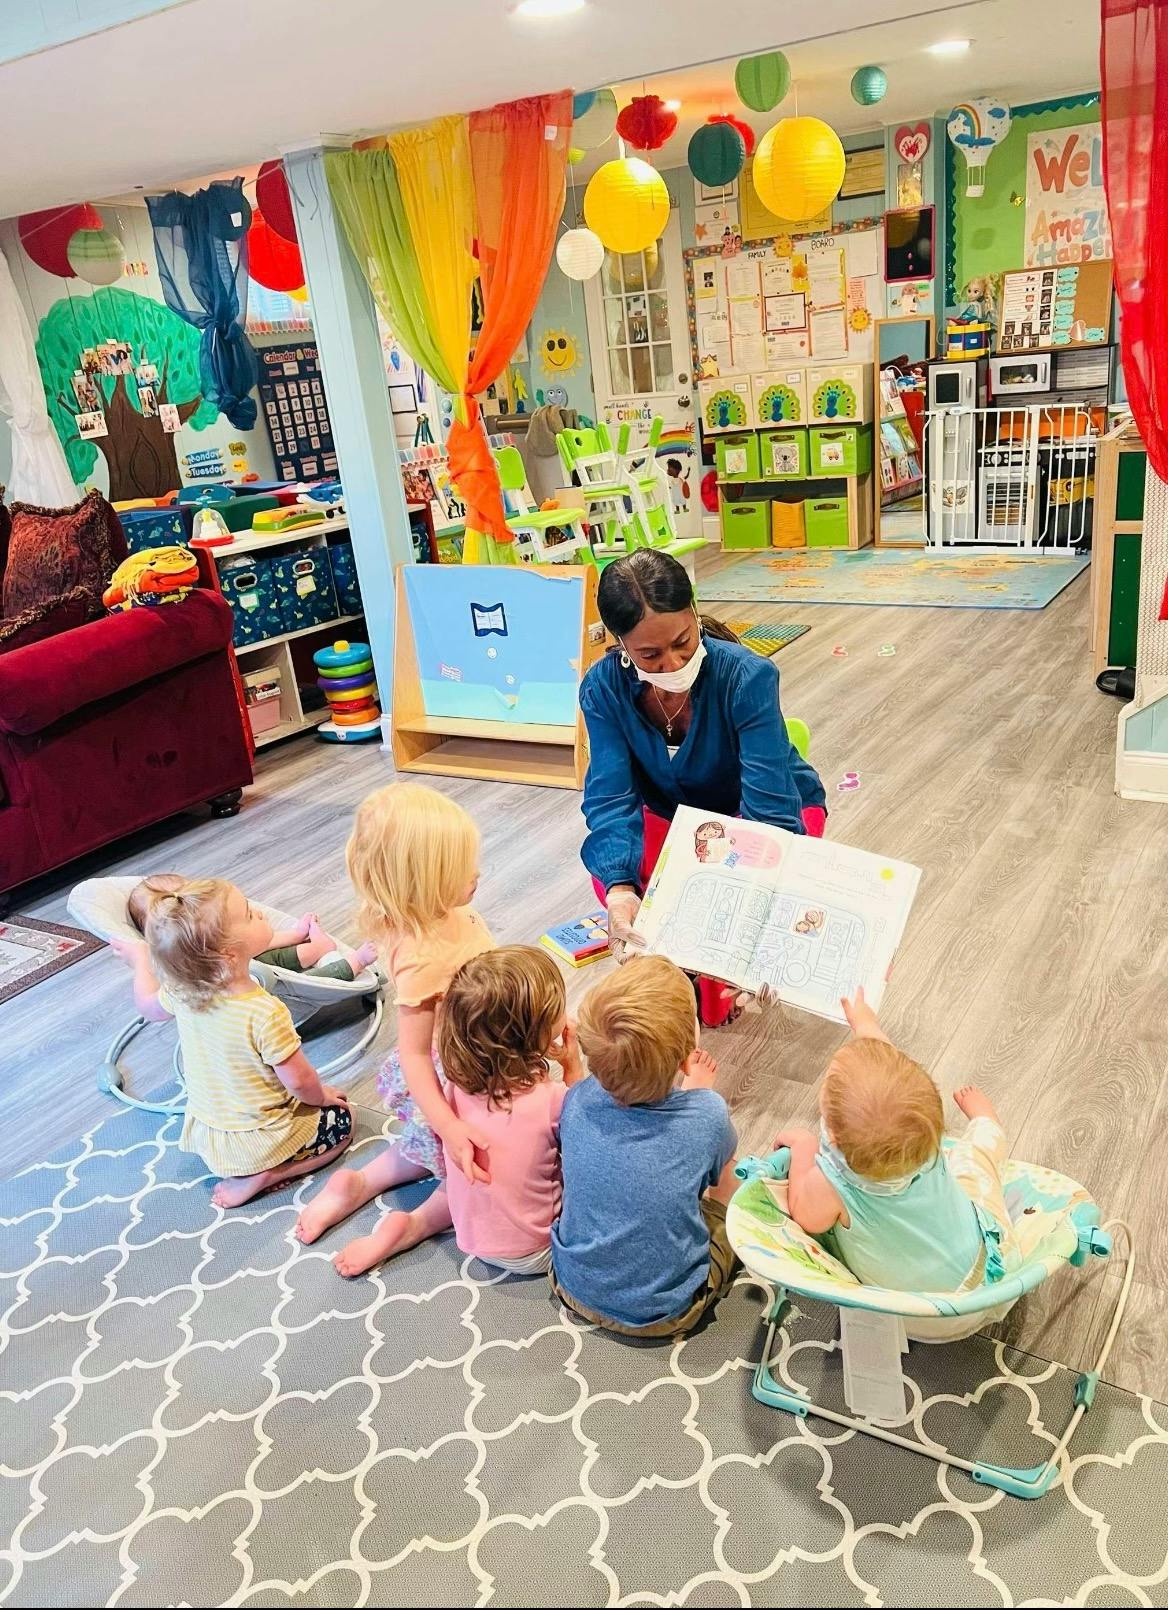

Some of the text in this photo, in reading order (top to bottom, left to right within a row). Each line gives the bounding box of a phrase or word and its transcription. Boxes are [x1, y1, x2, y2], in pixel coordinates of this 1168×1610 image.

[748, 237, 835, 260] FAMILY BOARD
[264, 351, 297, 364] Calendar
[617, 408, 652, 421] CHANGE
[189, 451, 220, 464] Monday
[191, 465, 224, 477] Tuesday
